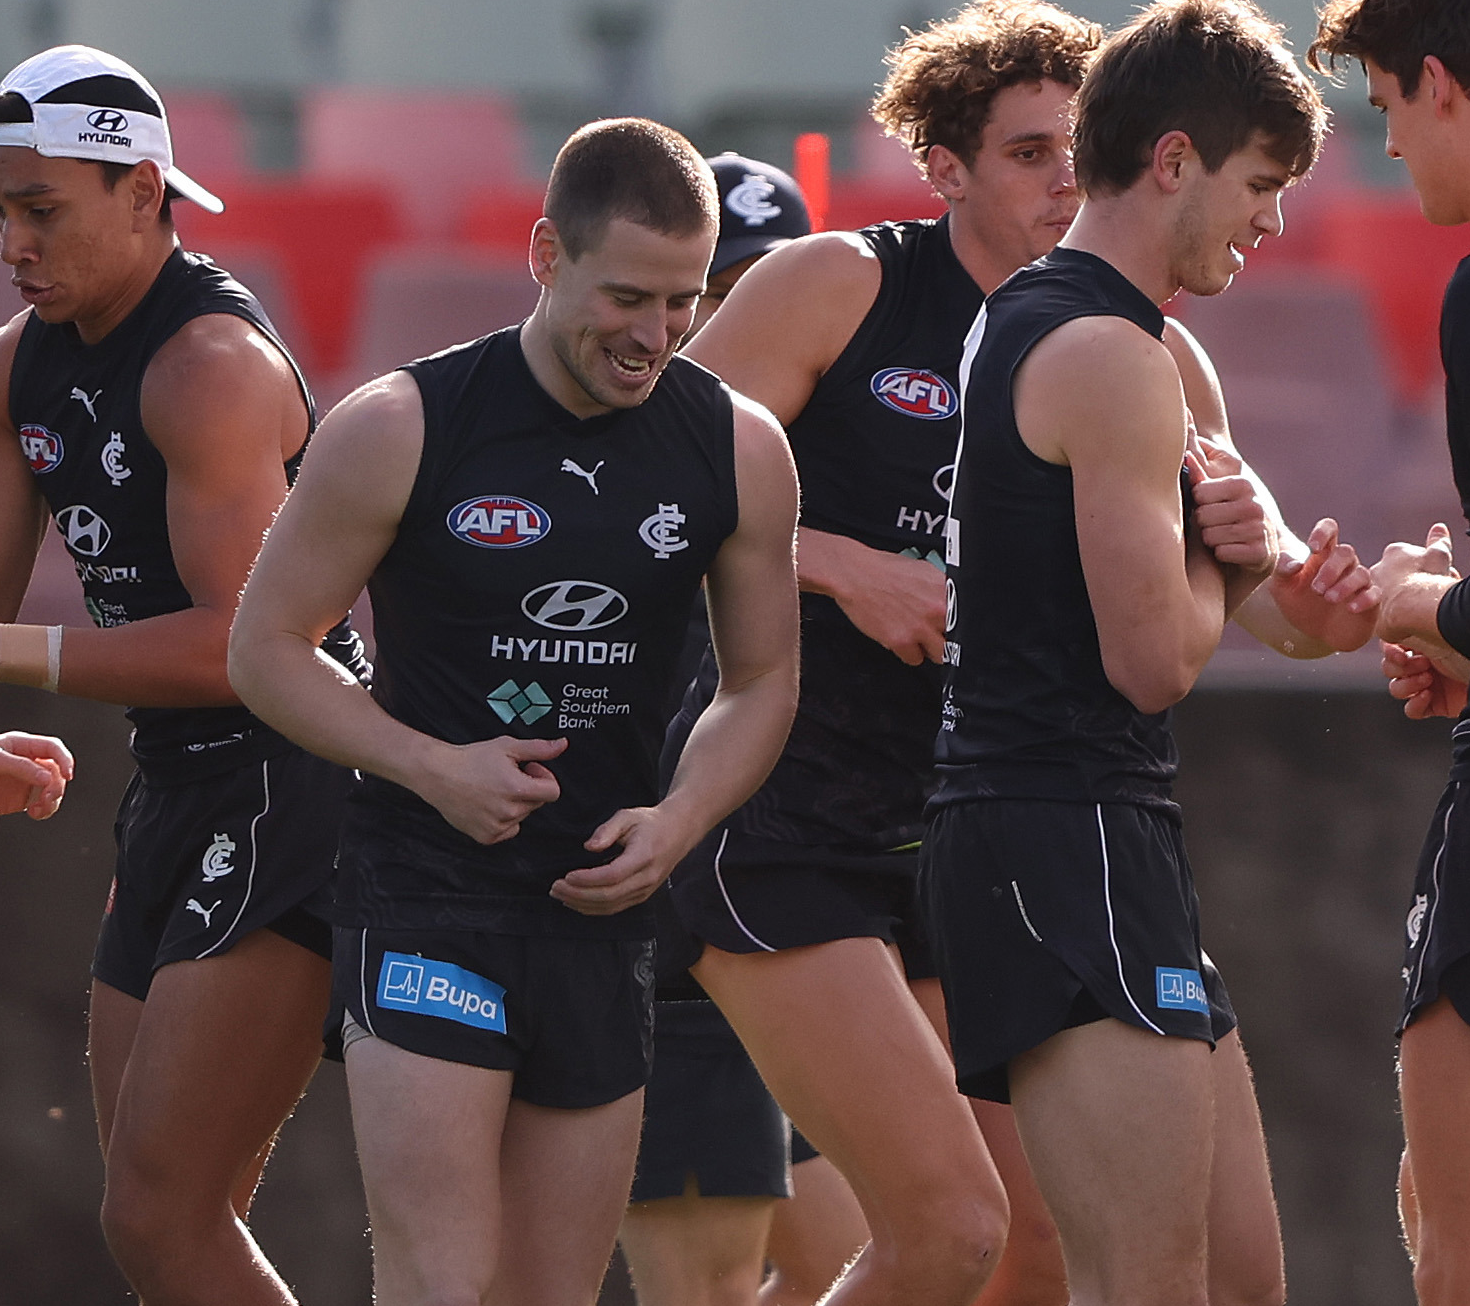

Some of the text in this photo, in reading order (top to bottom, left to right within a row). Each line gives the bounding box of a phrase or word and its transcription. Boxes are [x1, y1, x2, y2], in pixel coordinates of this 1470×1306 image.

[78, 131, 132, 149] HYUNDAI
[877, 375, 949, 414] AFL
[456, 507, 541, 536] AFL
[491, 634, 637, 665] HYUNDAI
[562, 683, 610, 700] Great
[559, 699, 630, 715] Southern
[558, 714, 598, 729] Bank
[425, 976, 497, 1020] Bupa
